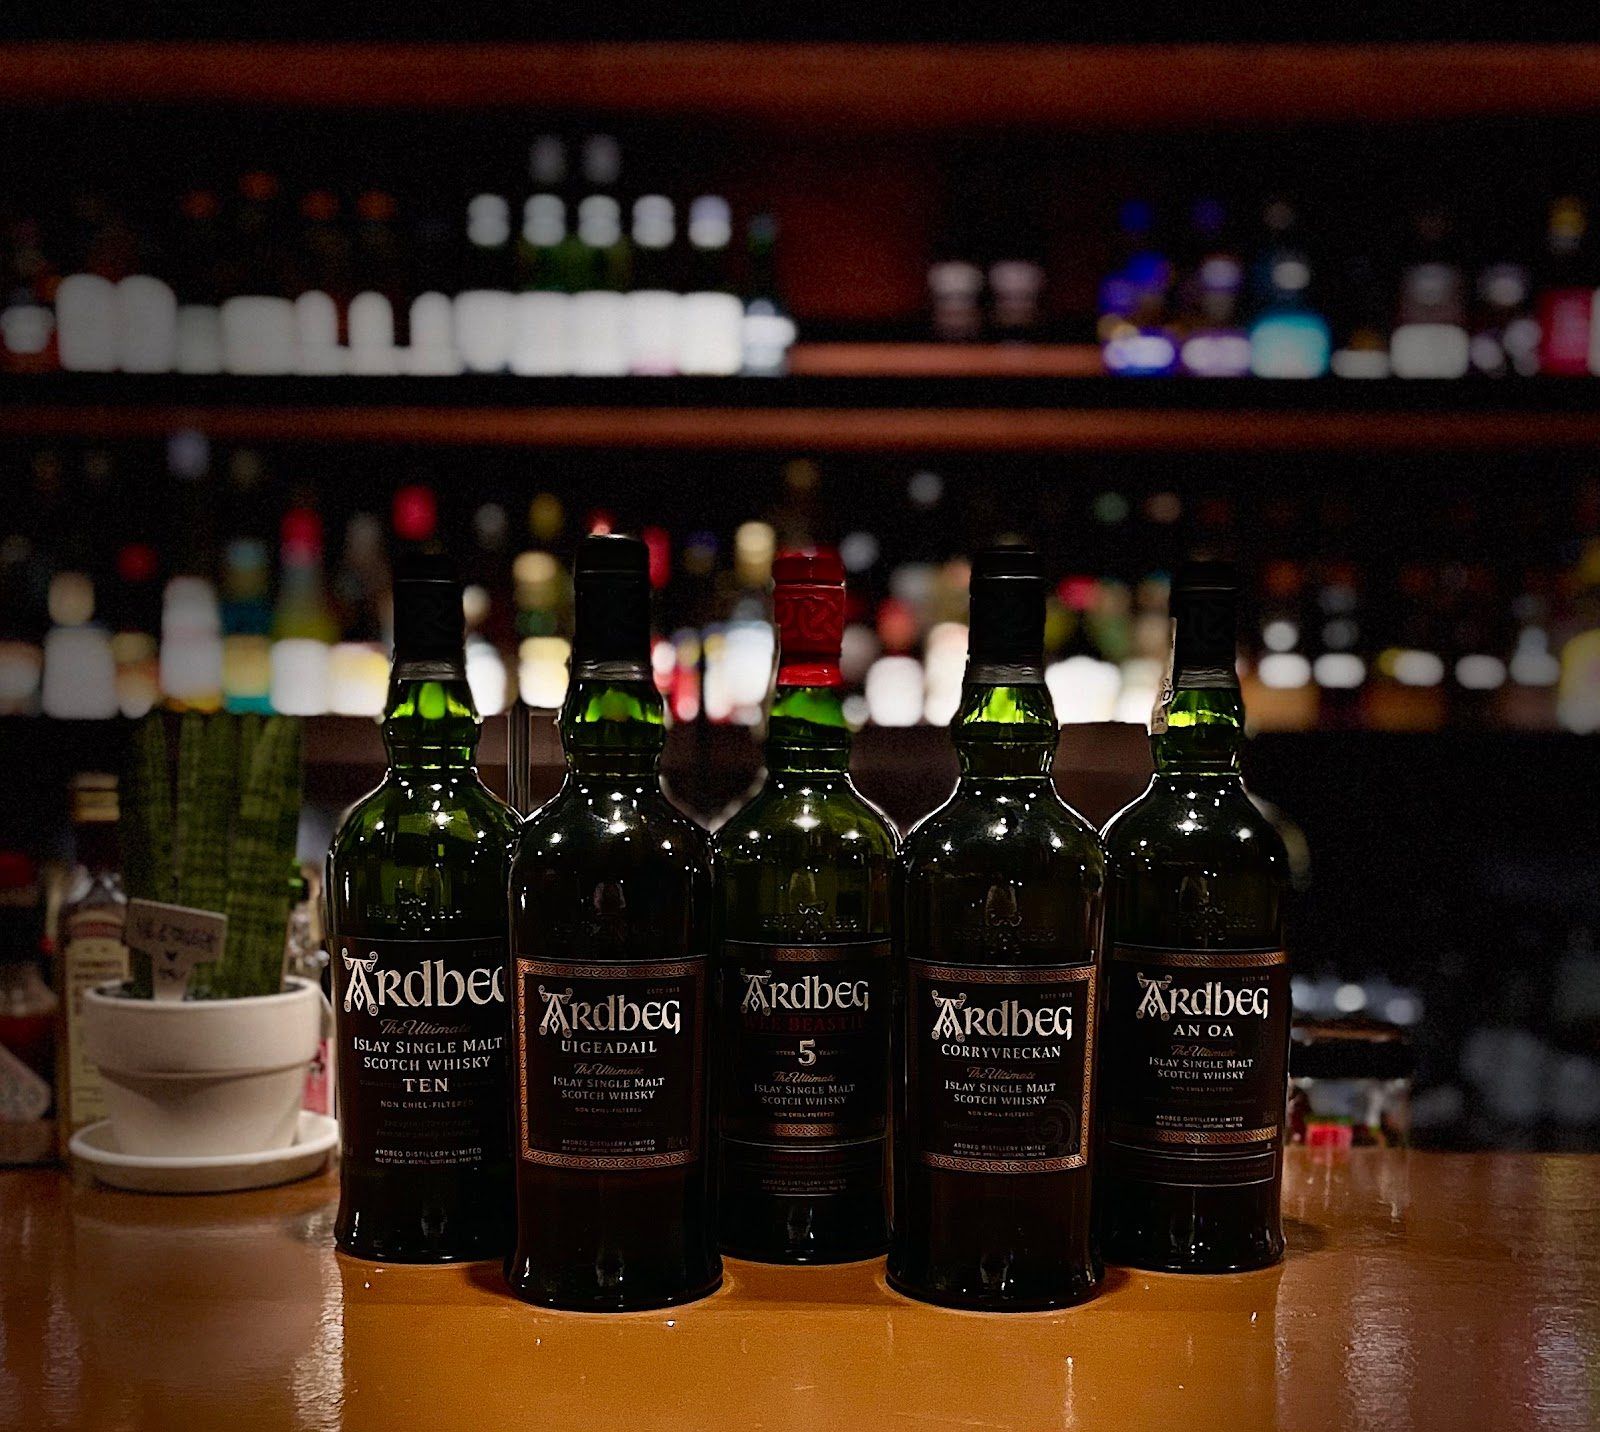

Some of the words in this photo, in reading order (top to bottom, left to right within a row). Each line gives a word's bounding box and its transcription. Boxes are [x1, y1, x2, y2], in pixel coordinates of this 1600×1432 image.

[380, 1018, 404, 1035] The
[1173, 1023, 1200, 1037] AN
[1207, 1024, 1234, 1037] OA
[353, 1036, 388, 1053] ISLAY
[396, 1041, 456, 1055] SINGLE
[463, 1036, 502, 1053] MALT
[561, 1040, 657, 1054] UIGEADAIL
[797, 1039, 817, 1066] 5
[941, 1043, 1061, 1059] CORRYVRECKAN
[363, 1056, 420, 1072] SCOTCH
[426, 1055, 491, 1071] WHISKY
[1182, 1059, 1223, 1069] SINGLE
[1226, 1059, 1254, 1069] MALT
[1157, 1069, 1198, 1079] SCOTCH
[1202, 1070, 1245, 1080] WHISKY
[402, 1077, 450, 1093] TEN
[553, 1076, 585, 1087] ISLAY
[588, 1078, 631, 1089] SINGLE
[634, 1077, 665, 1088] MALT
[785, 1086, 825, 1095] SINGLE
[828, 1083, 856, 1093] MALT
[945, 1080, 976, 1092] ISLAY
[979, 1082, 1023, 1094] SINGLE
[1027, 1082, 1056, 1093] MALT
[561, 1089, 605, 1101] SCOTCH
[609, 1090, 656, 1101] WHISKY
[762, 1096, 802, 1106] SCOTCH
[805, 1096, 848, 1106] WHISKY
[953, 1094, 997, 1105] SCOTCH
[1001, 1095, 1047, 1106] WHISKY
